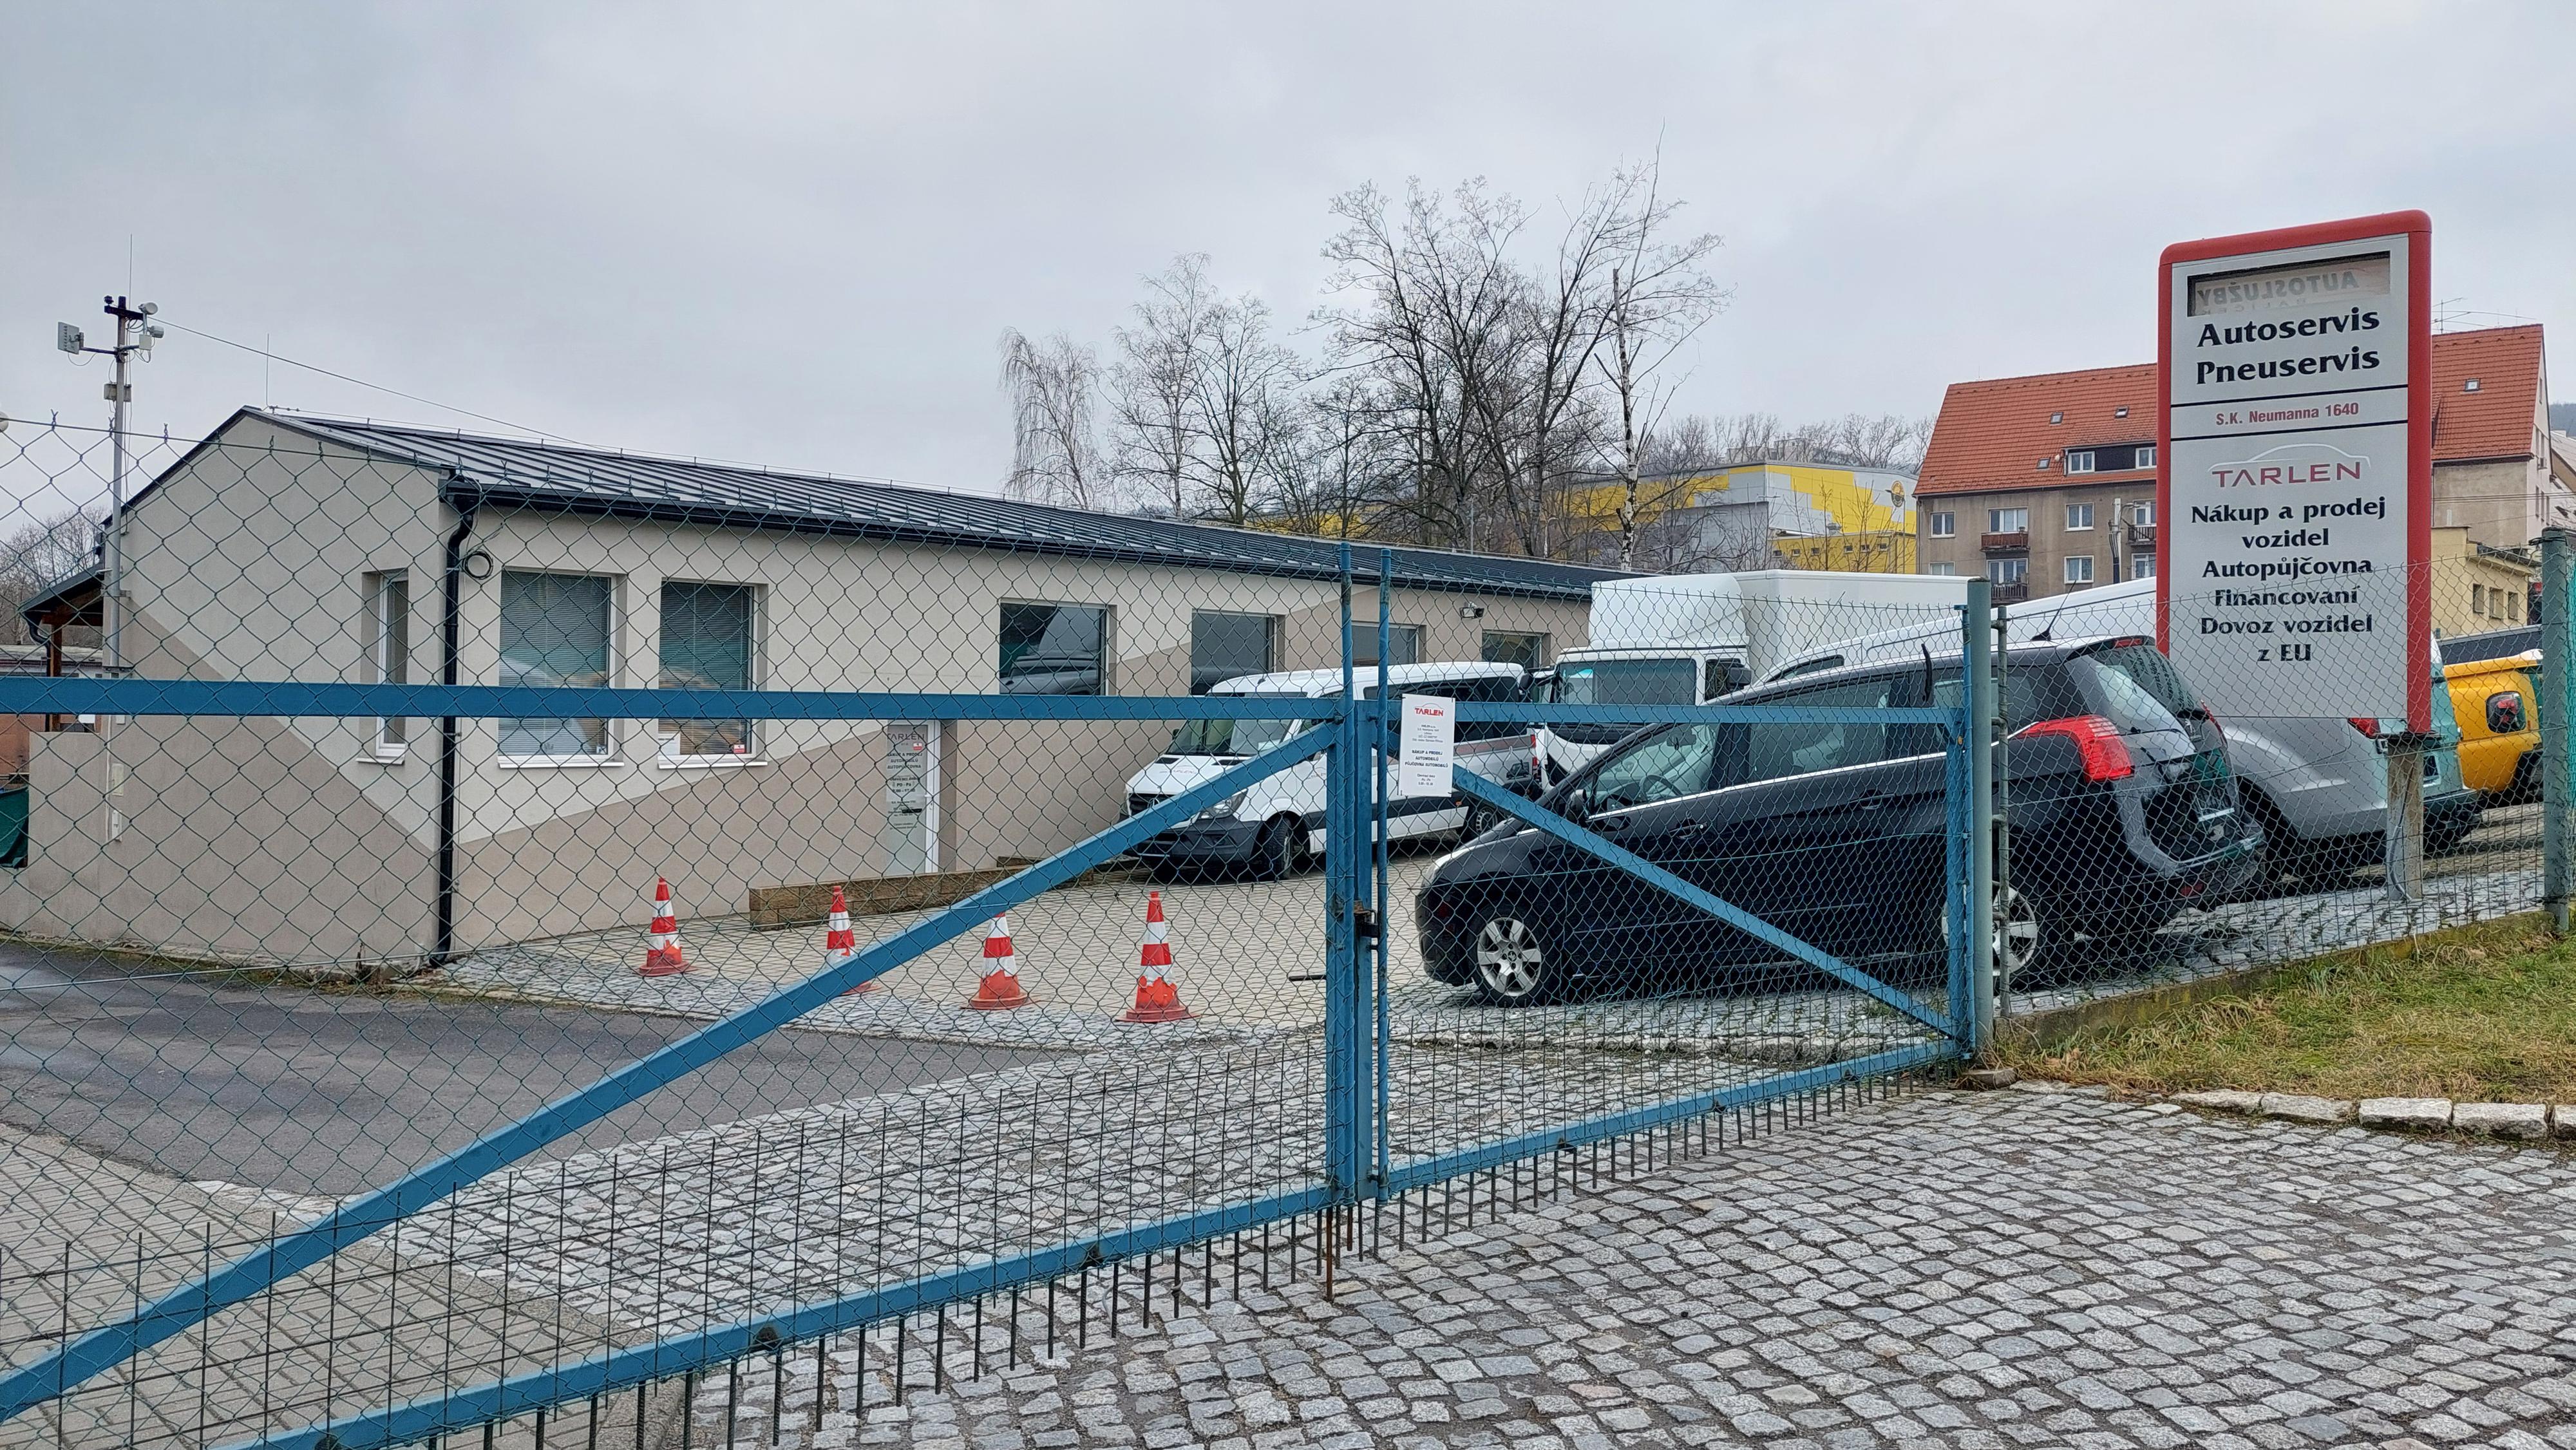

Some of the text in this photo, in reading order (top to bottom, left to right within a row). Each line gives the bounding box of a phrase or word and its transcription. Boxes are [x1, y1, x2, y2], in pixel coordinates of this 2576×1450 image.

[2197, 307, 2380, 348] Autoservis
[2197, 346, 2380, 385] Pneuservis
[2215, 402, 2360, 426] S.K. Neumanna 1640
[2211, 461, 2361, 488] TARLEN
[2191, 496, 2387, 525] Nákup a prodej
[2242, 528, 2329, 549] vozidel
[2202, 556, 2372, 581] Autopůjčovna
[2214, 585, 2361, 607] Financovaní
[2201, 614, 2373, 635] Dovoz vozidel
[2257, 643, 2312, 662] z EU
[1414, 707, 1443, 717] TARLEN
